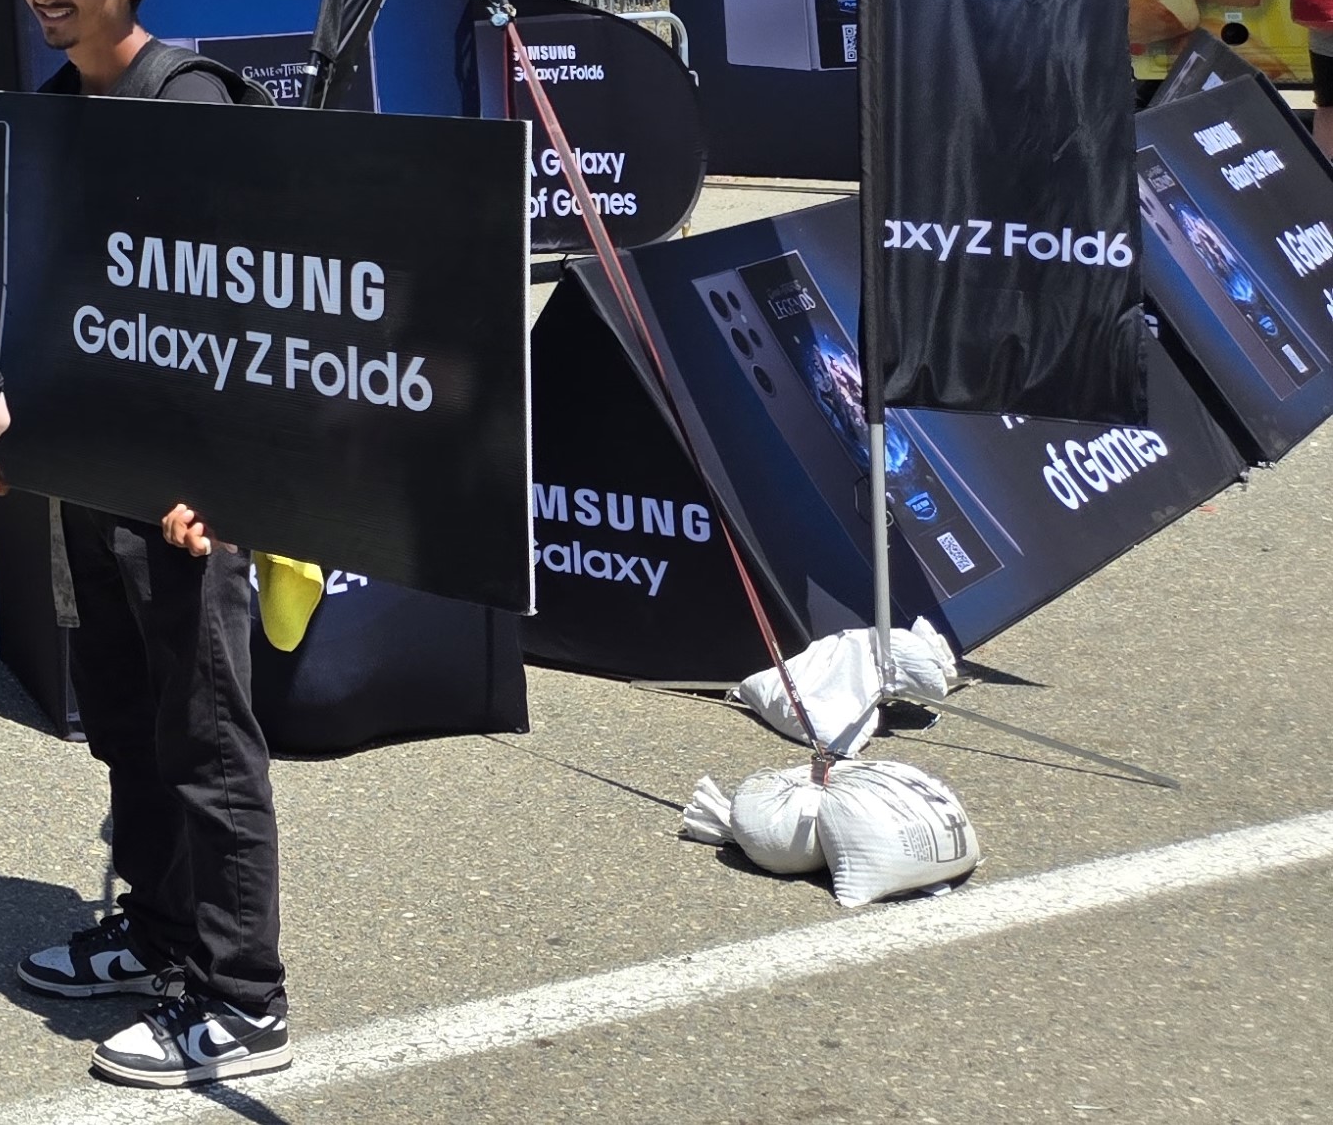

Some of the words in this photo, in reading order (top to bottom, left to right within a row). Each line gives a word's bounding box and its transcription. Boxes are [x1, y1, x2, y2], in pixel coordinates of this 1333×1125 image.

[242, 66, 275, 78] GAME
[560, 65, 569, 80] Z
[569, 64, 605, 81] Fold6
[1193, 121, 1242, 156] SAMSUNG
[540, 147, 626, 183] Glaxy
[530, 187, 548, 219] of
[965, 219, 993, 255] Z
[1003, 222, 1134, 268] Fold6
[1275, 236, 1310, 278] A
[107, 230, 385, 323] SAMSUNG
[72, 304, 238, 392] Galaxy
[243, 332, 274, 387] Z
[285, 336, 434, 413] Fold6
[1042, 442, 1089, 510] of
[1064, 428, 1169, 493] Games
